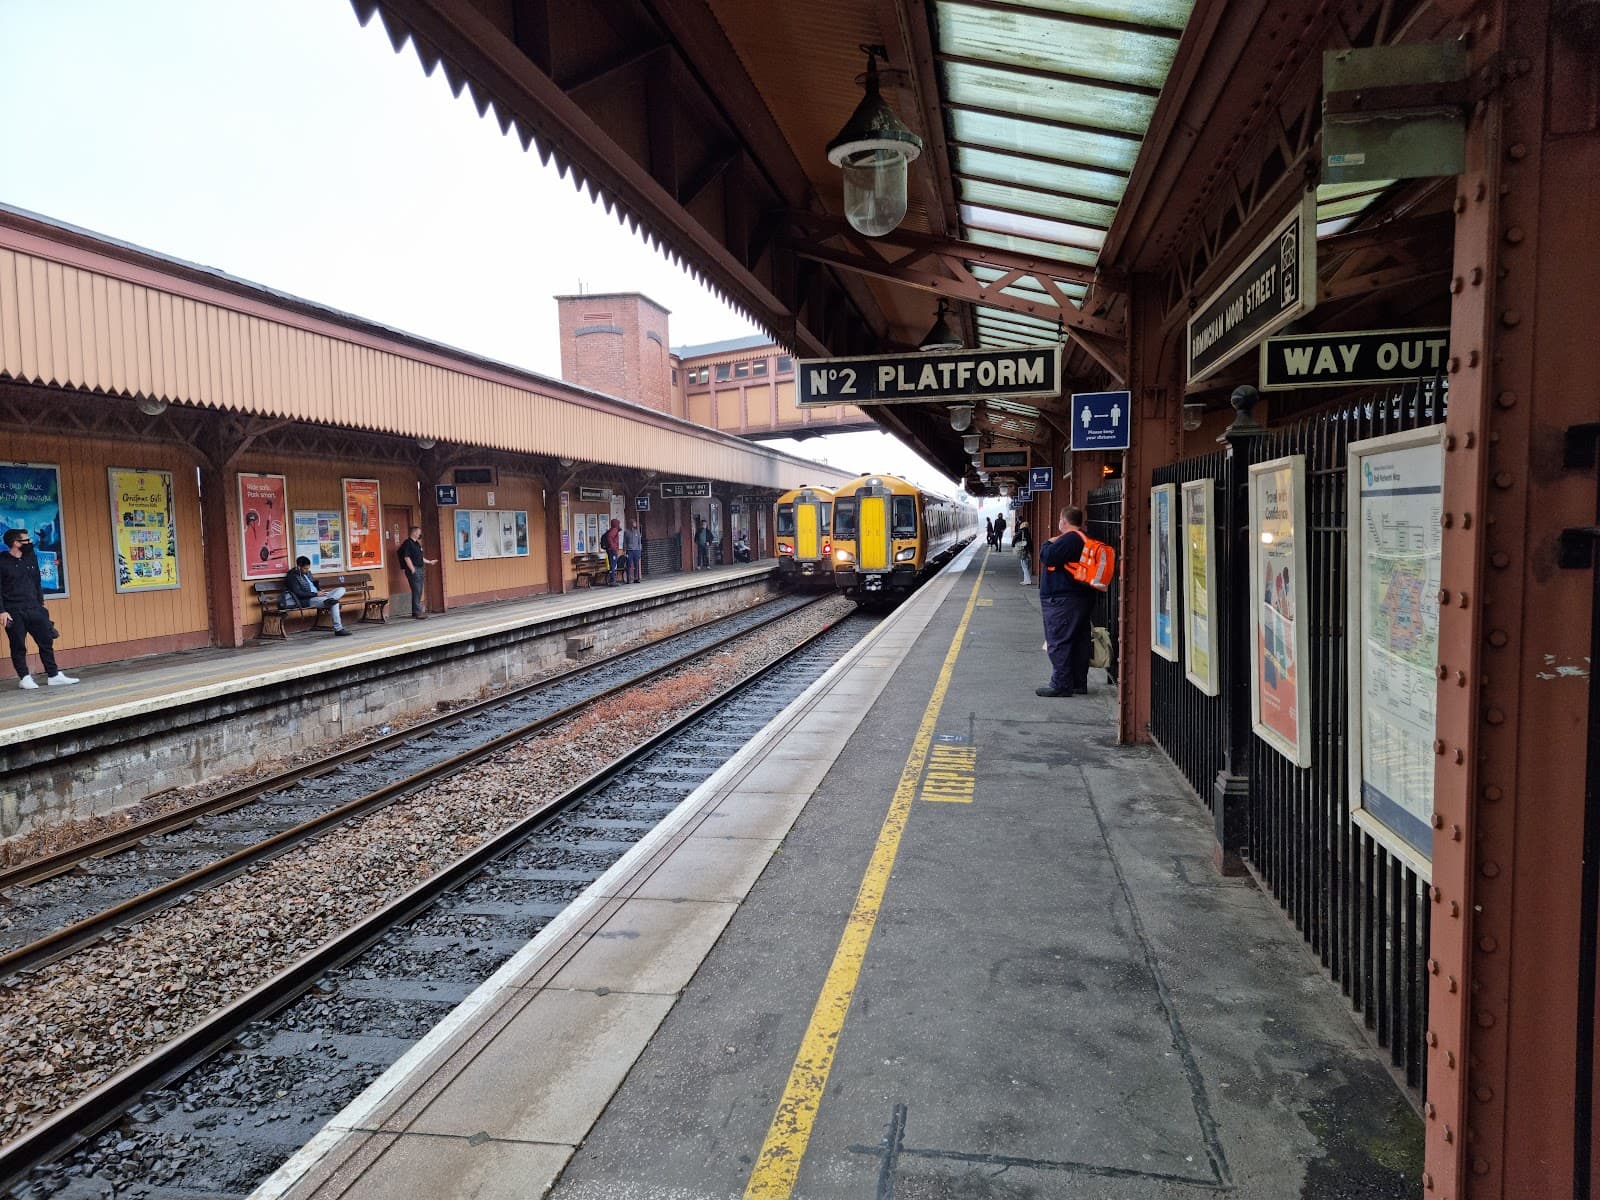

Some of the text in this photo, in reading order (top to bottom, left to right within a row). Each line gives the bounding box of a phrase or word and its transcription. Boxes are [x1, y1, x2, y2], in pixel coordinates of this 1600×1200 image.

[1192, 263, 1277, 360] BIRMINGHAM MOOR STREET
[878, 356, 1045, 392] PLATFORM
[1283, 339, 1447, 376] WAY OUT
[1265, 505, 1288, 520] Confidence
